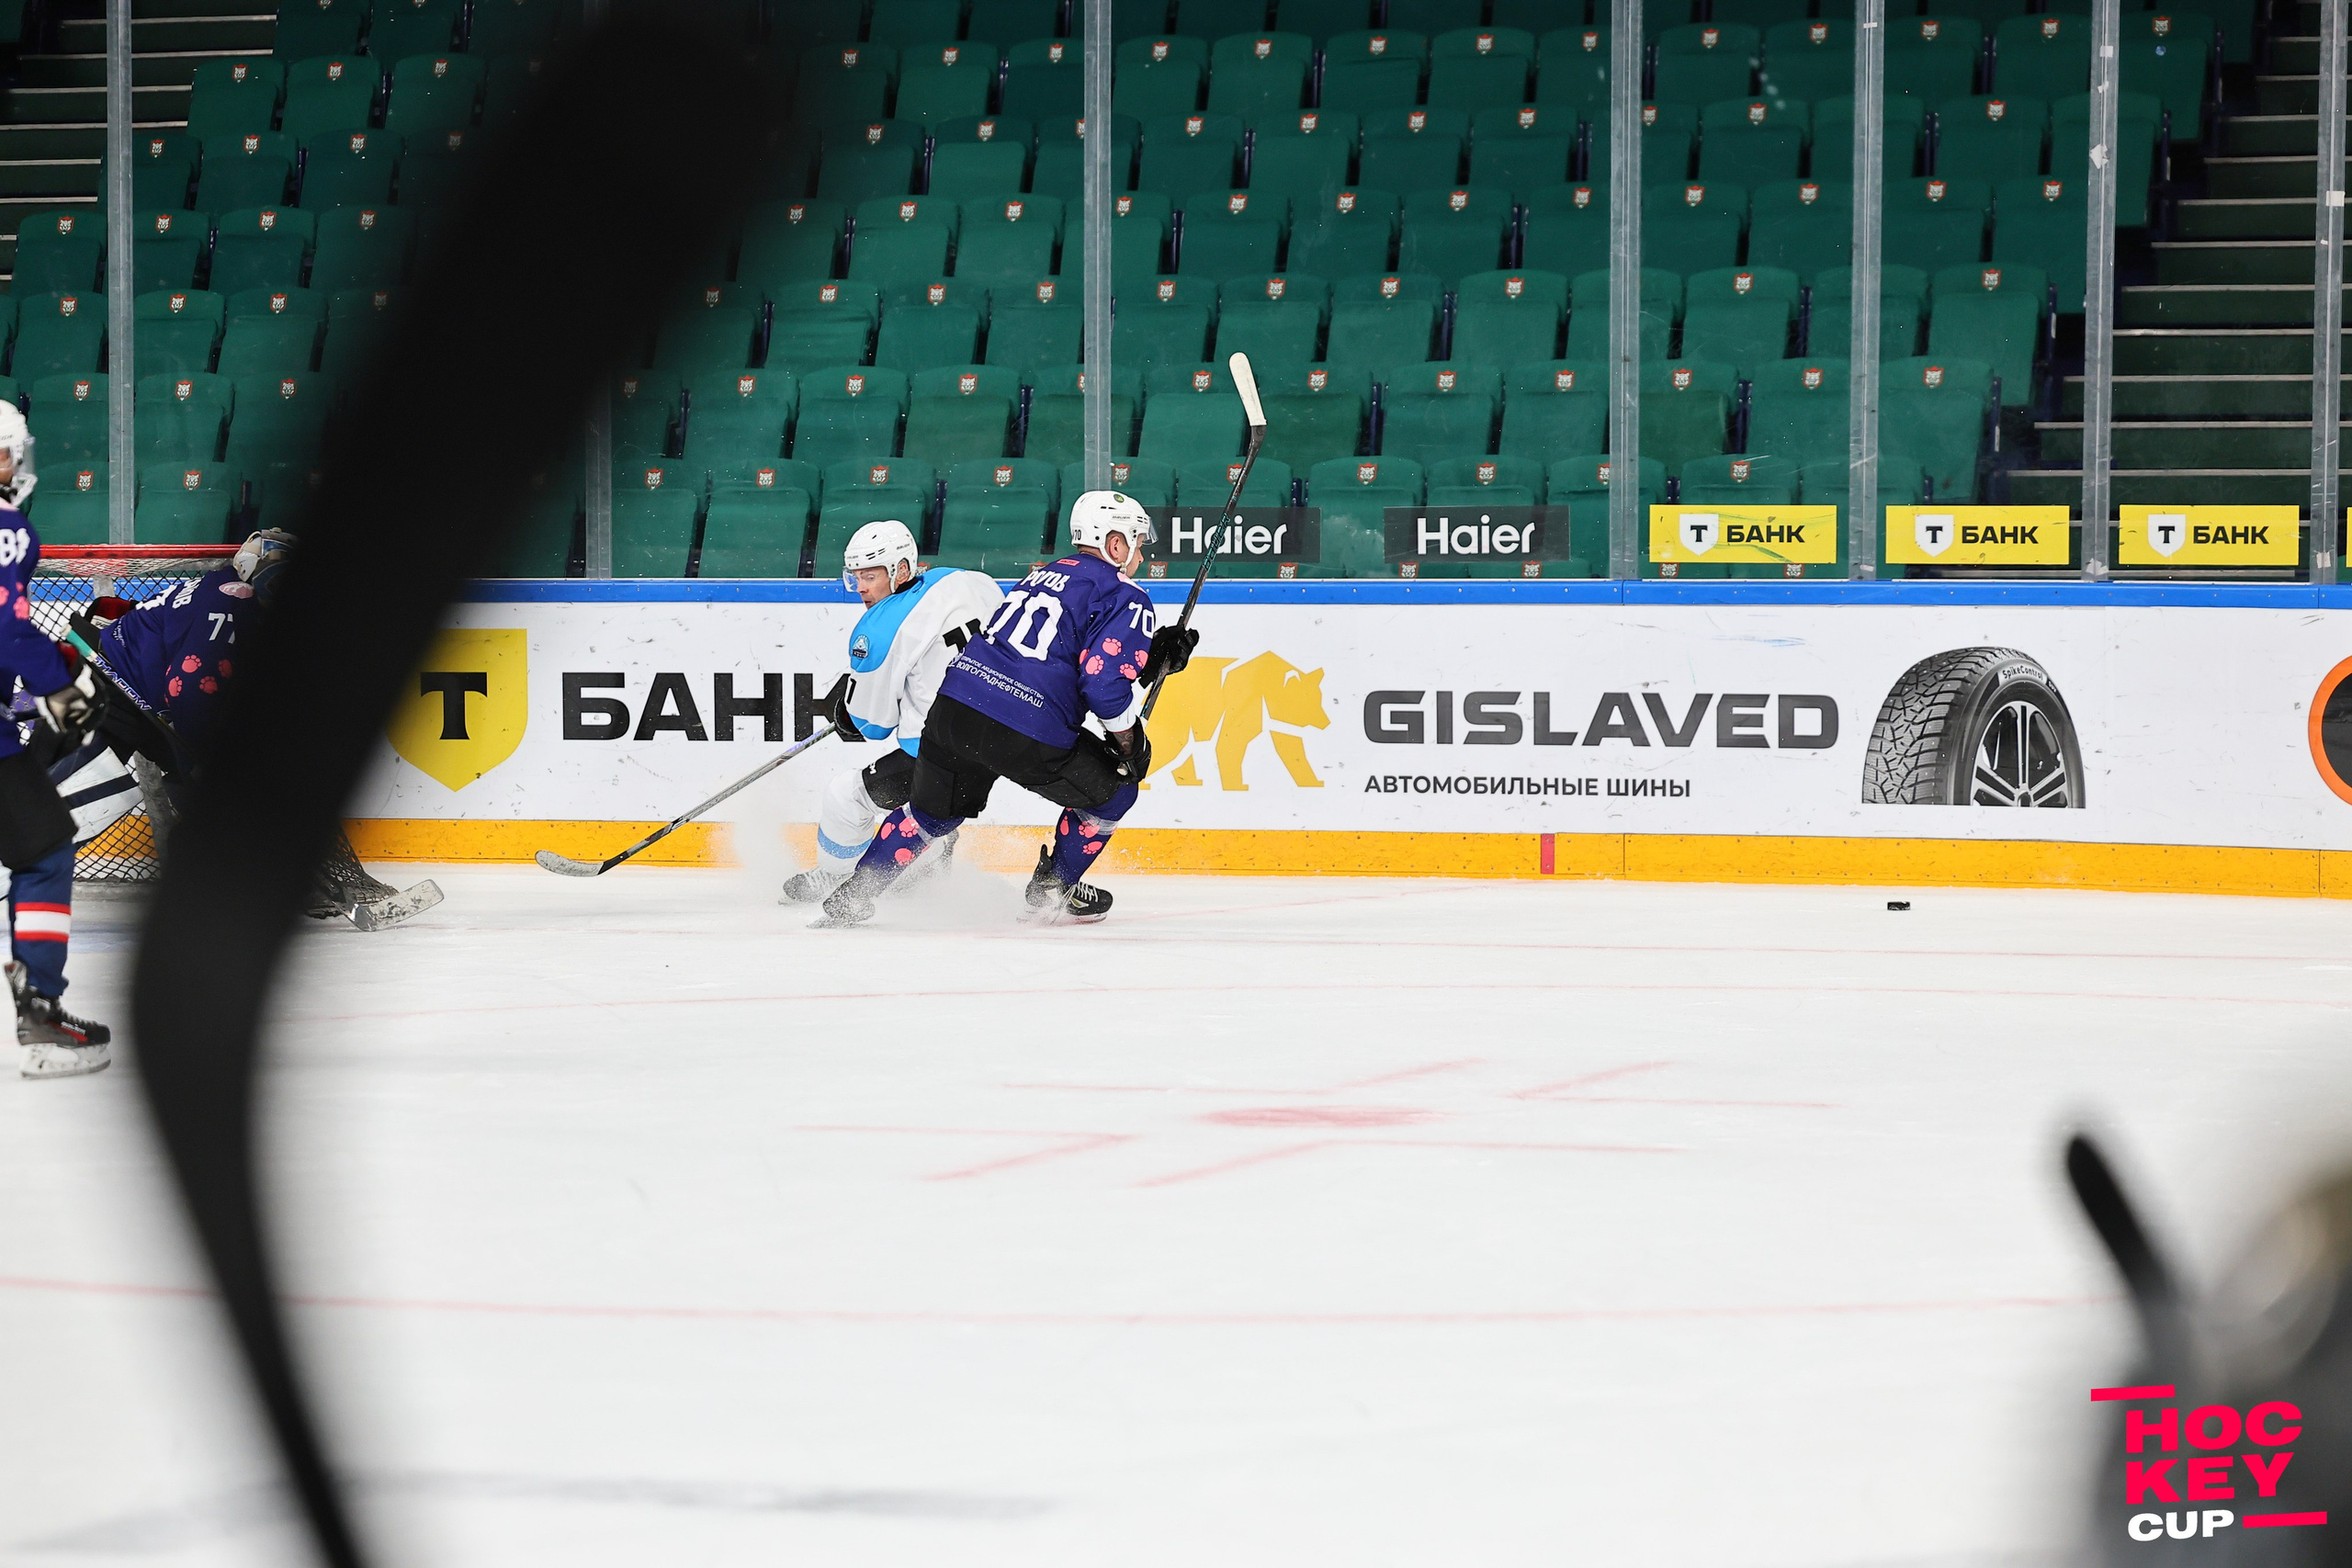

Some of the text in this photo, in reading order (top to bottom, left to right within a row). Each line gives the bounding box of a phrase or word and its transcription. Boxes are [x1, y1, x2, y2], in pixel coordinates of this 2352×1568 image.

[1171, 515, 1287, 555] Haier
[1417, 514, 1536, 556] Haier
[1726, 525, 1805, 544] БАНК
[1962, 525, 2039, 544] БАНК
[2192, 525, 2269, 545] БАНК
[985, 590, 1064, 661] 70
[1128, 602, 1155, 639] 70
[956, 660, 1044, 708] ВОЛГОГРАДНЕФТЕМАШ
[2002, 665, 2044, 681] SpikeControl
[561, 671, 867, 742] БАНК
[1363, 690, 1839, 750] GISLAVED
[1364, 774, 1691, 798] АВТОМОБИЛЬНЫЕ ШИНЫ
